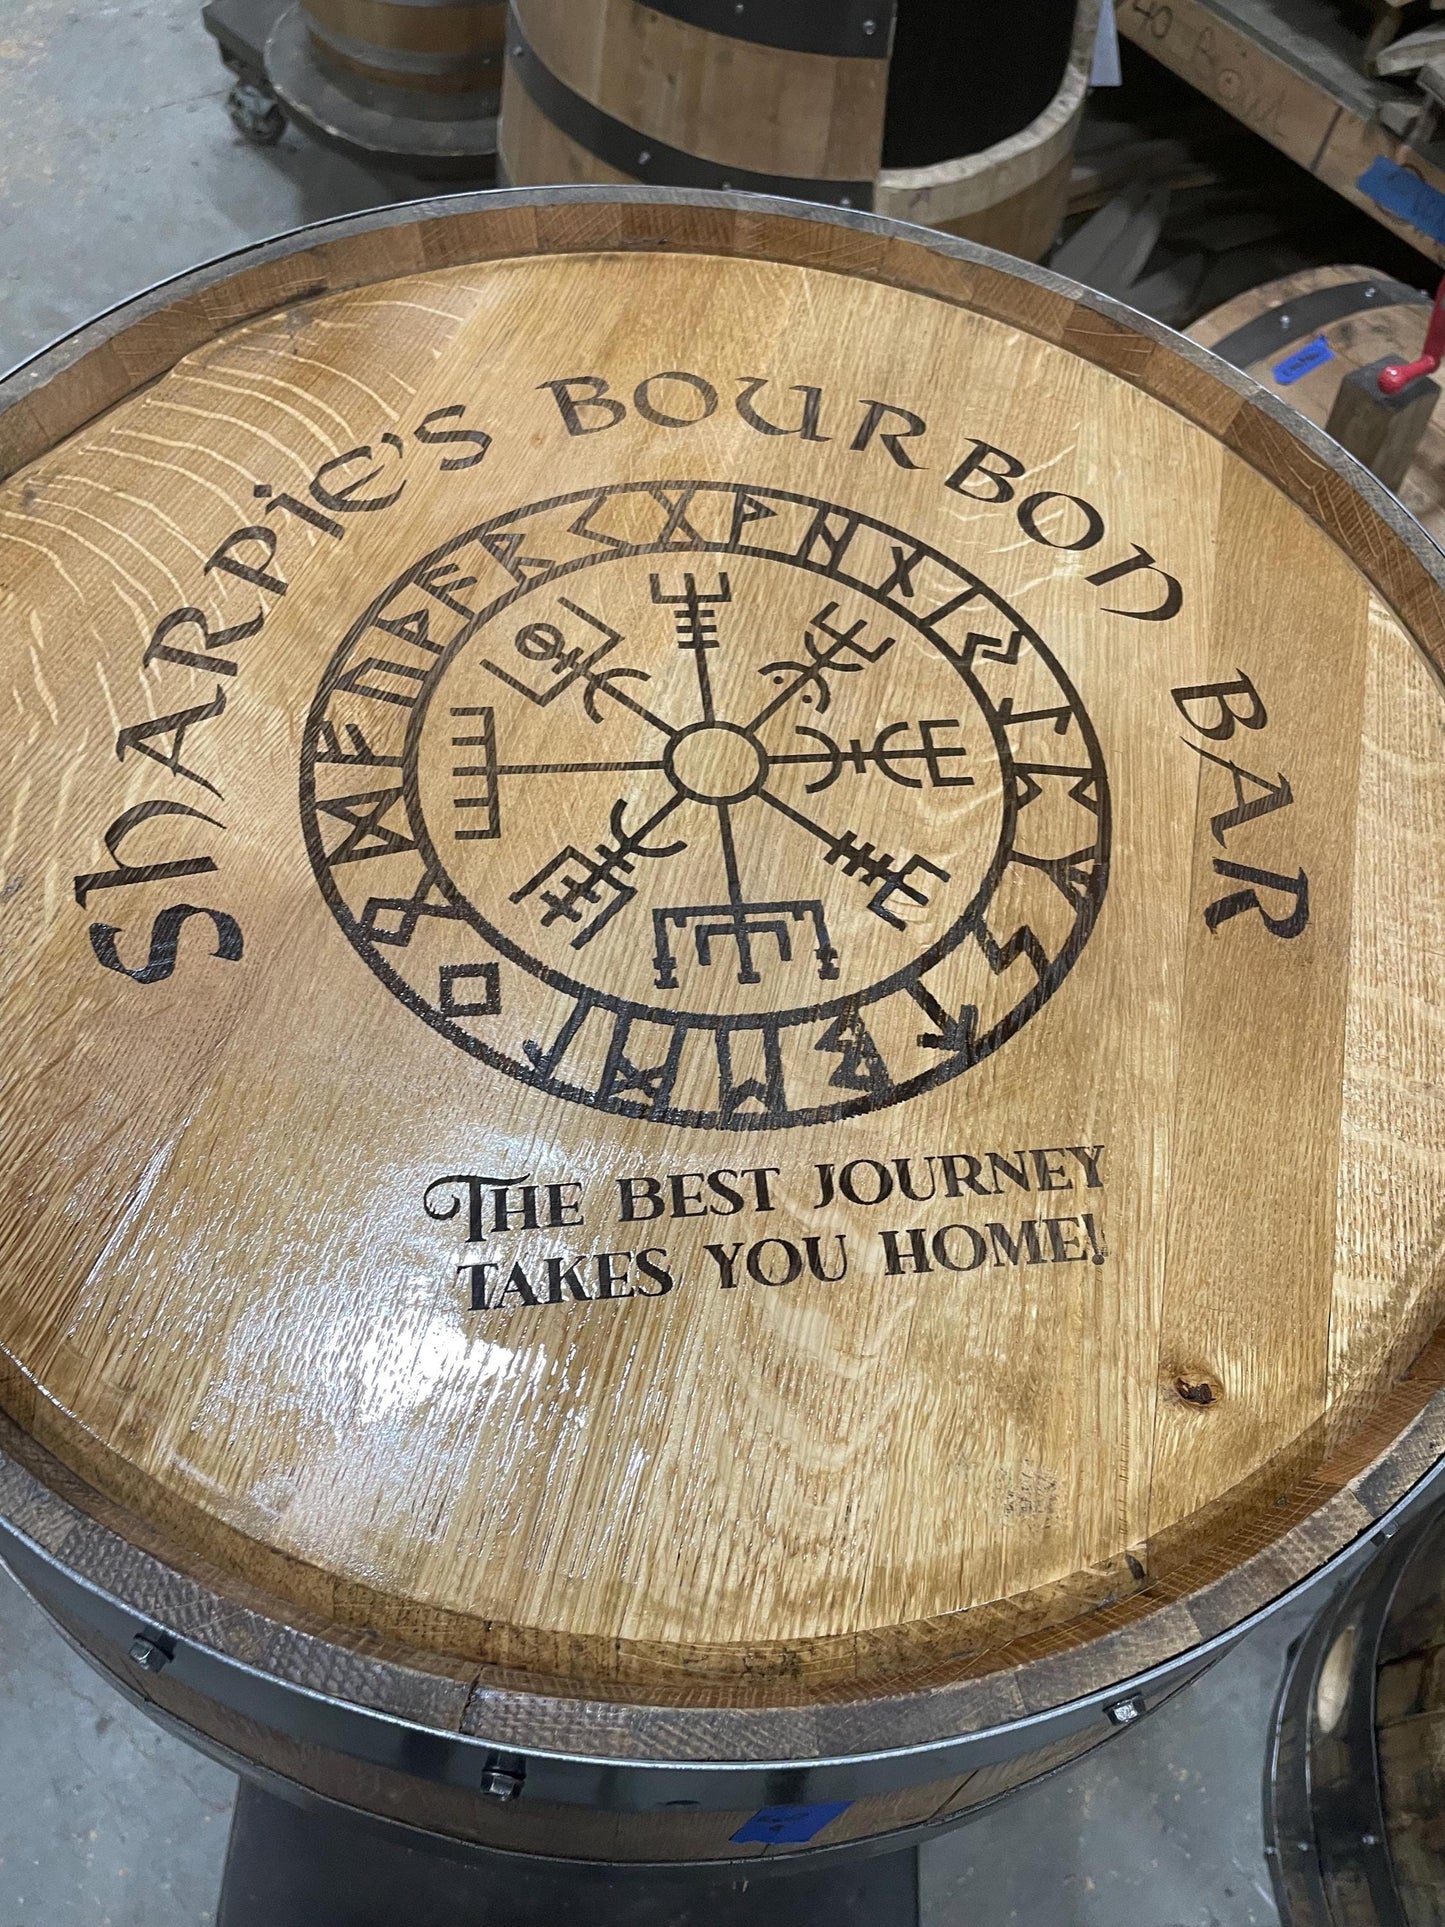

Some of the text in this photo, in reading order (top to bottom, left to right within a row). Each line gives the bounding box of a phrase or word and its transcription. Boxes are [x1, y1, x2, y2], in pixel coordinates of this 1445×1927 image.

[1170, 667, 1310, 940] BAR
[423, 1144, 1106, 1243] THE BEST JOURNEY
[456, 1213, 1107, 1312] TAKES YOU HOME!
